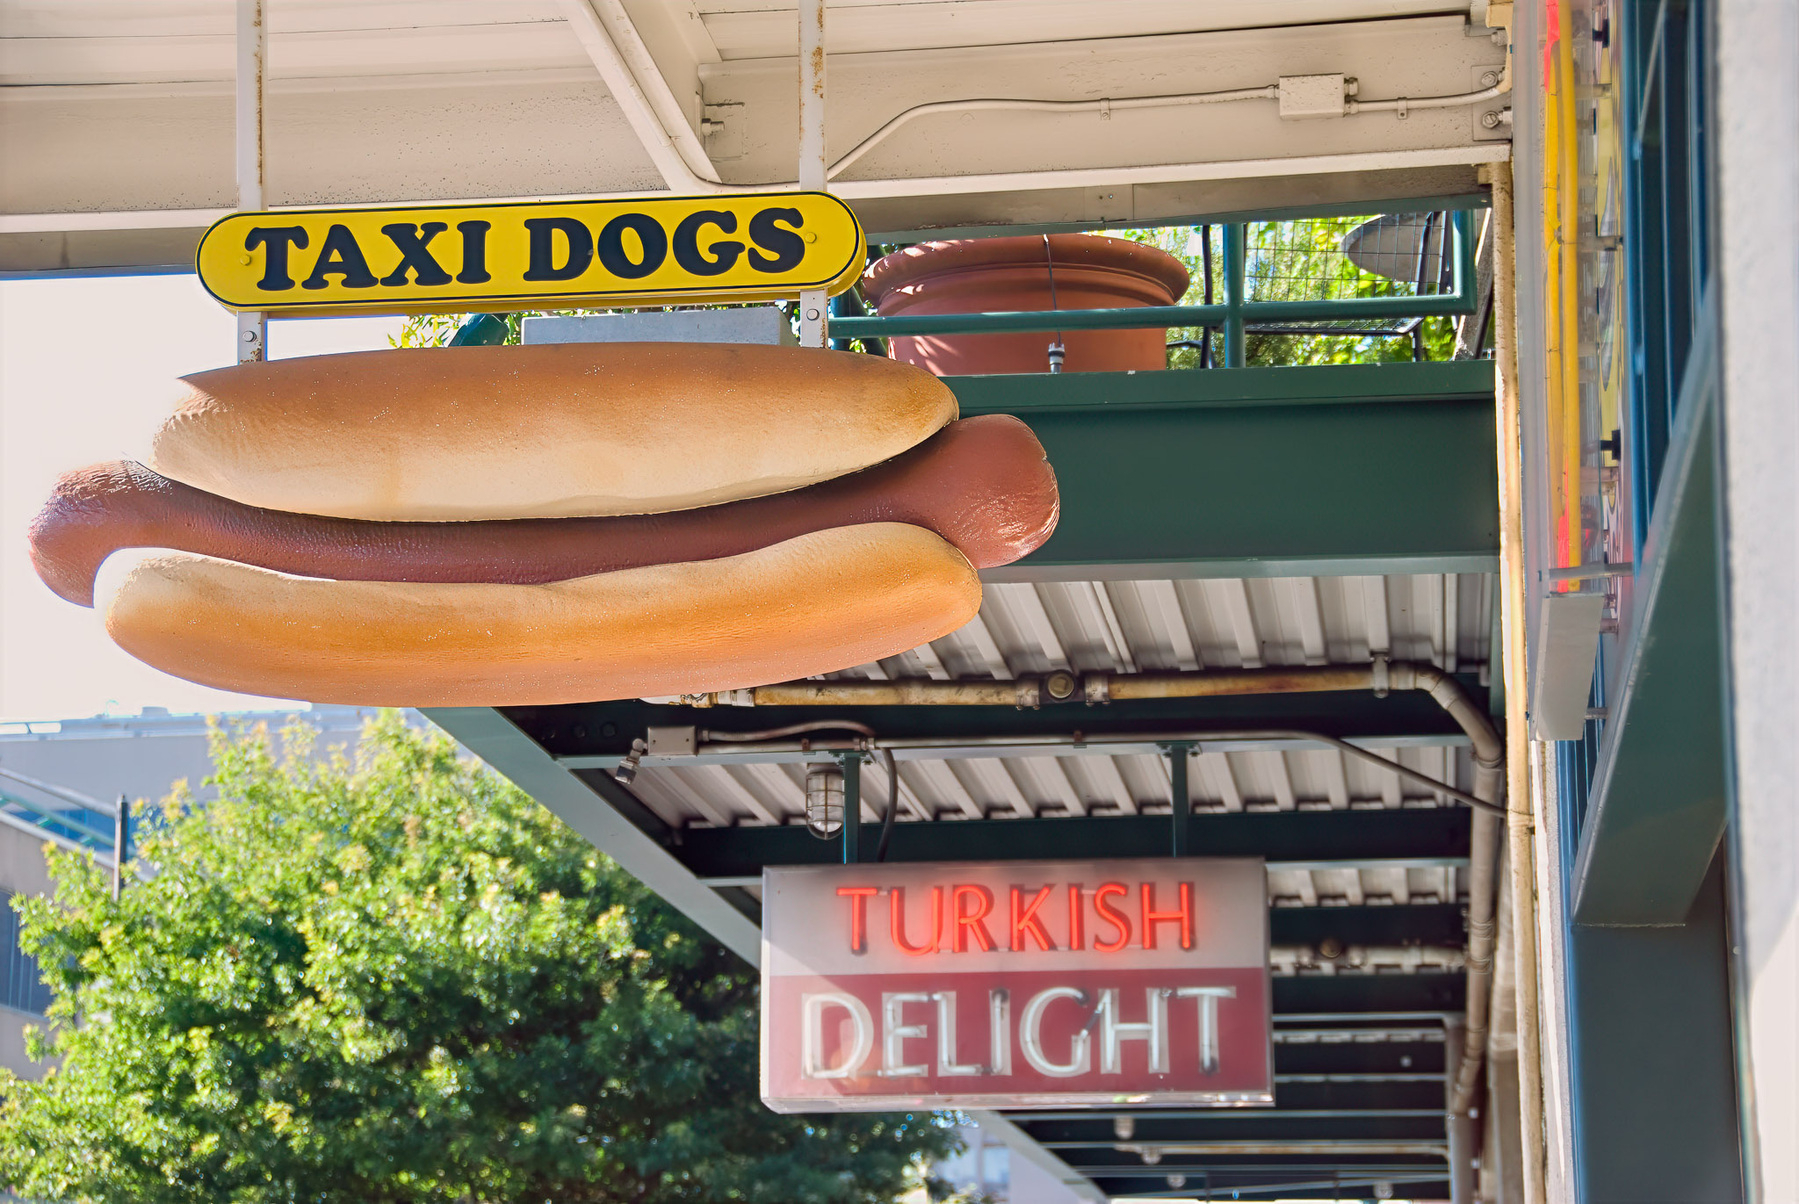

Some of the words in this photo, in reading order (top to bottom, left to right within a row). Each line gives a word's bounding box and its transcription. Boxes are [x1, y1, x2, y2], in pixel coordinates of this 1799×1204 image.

[244, 220, 492, 291] TAXI
[523, 207, 806, 282] DOGS
[836, 882, 1195, 956] TURKISH
[801, 987, 1237, 1079] DELIGHT
